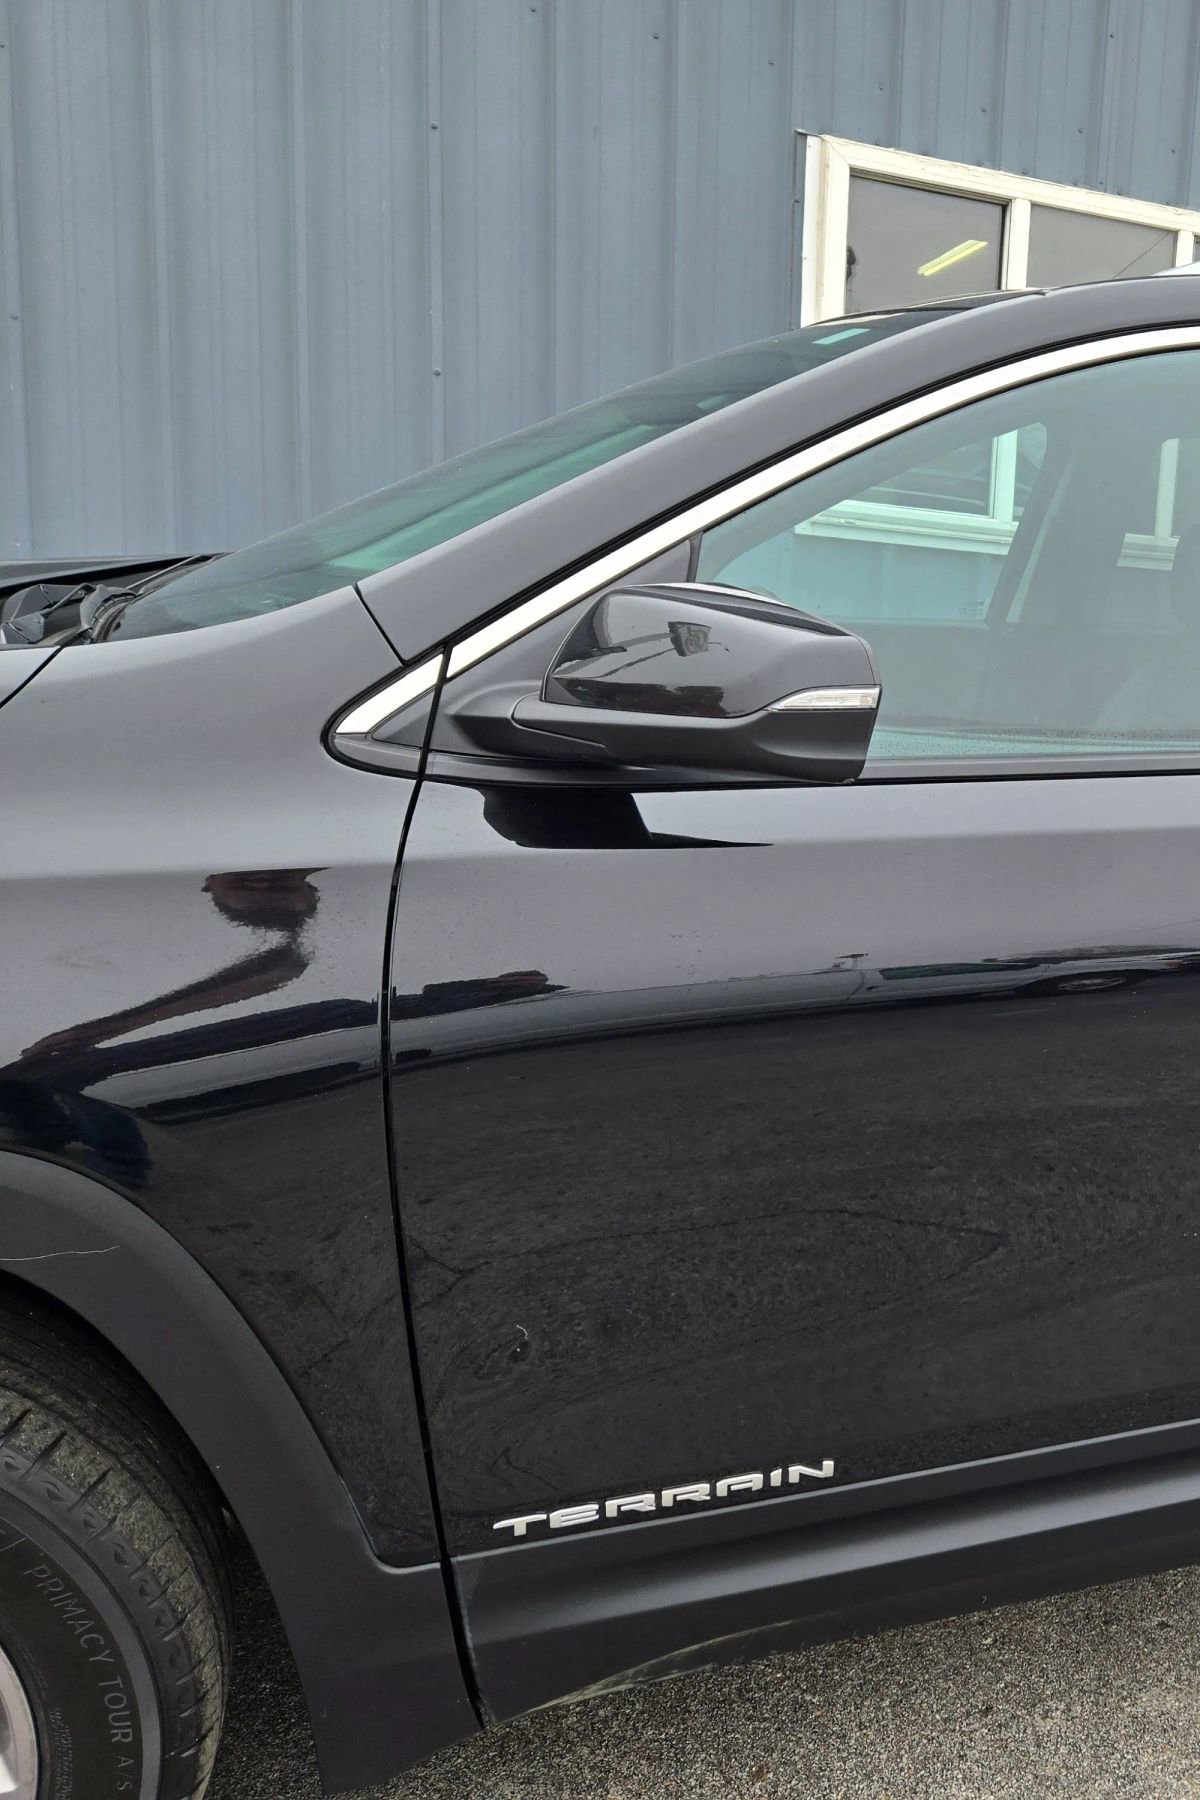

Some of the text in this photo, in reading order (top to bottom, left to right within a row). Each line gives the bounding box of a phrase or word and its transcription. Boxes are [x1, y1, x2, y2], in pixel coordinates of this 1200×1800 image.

[493, 1459, 835, 1537] TERRAIN
[23, 1565, 134, 1791] PRIMACY TOUR A/S
